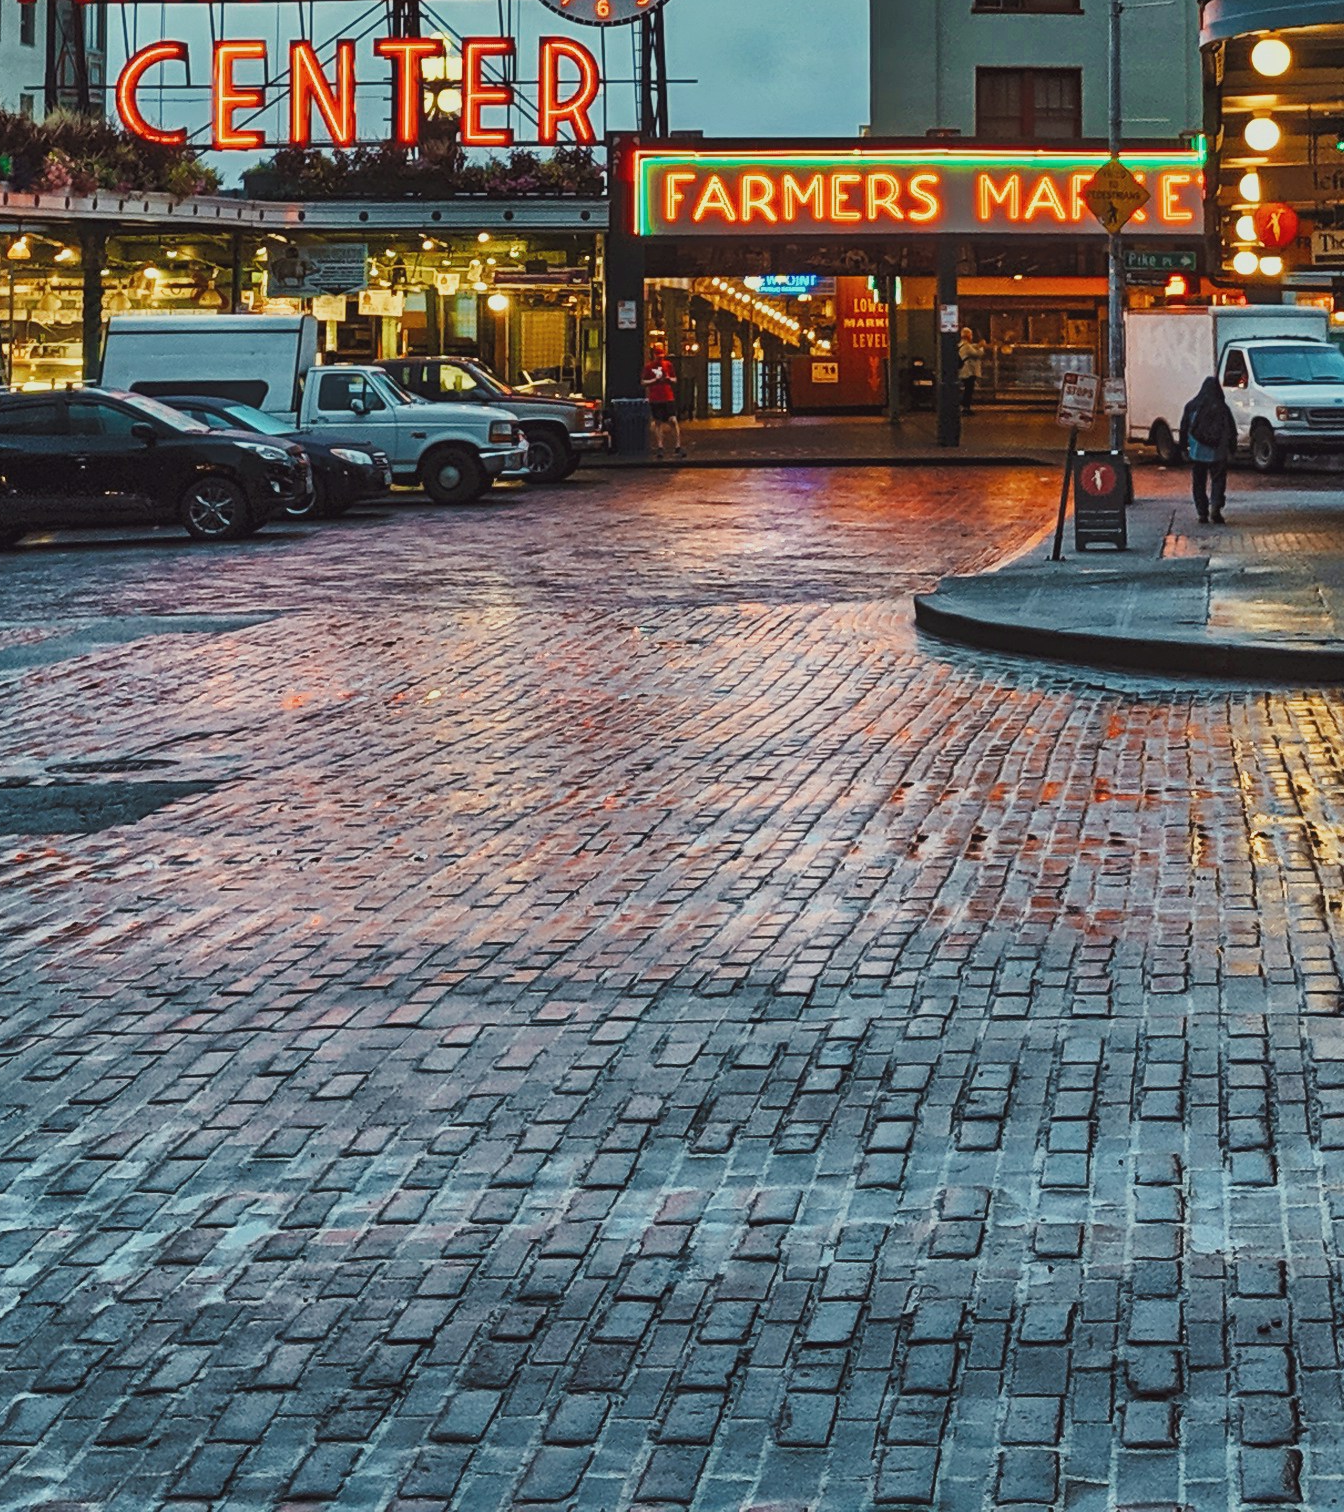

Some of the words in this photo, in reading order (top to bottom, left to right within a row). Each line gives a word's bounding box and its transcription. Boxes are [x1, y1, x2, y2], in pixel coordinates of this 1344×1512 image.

[596, 0, 609, 17] 6
[116, 36, 601, 150] CENTER
[665, 173, 939, 223] FARMERS
[1128, 252, 1156, 266] Pike
[852, 333, 888, 348] LEVEL
